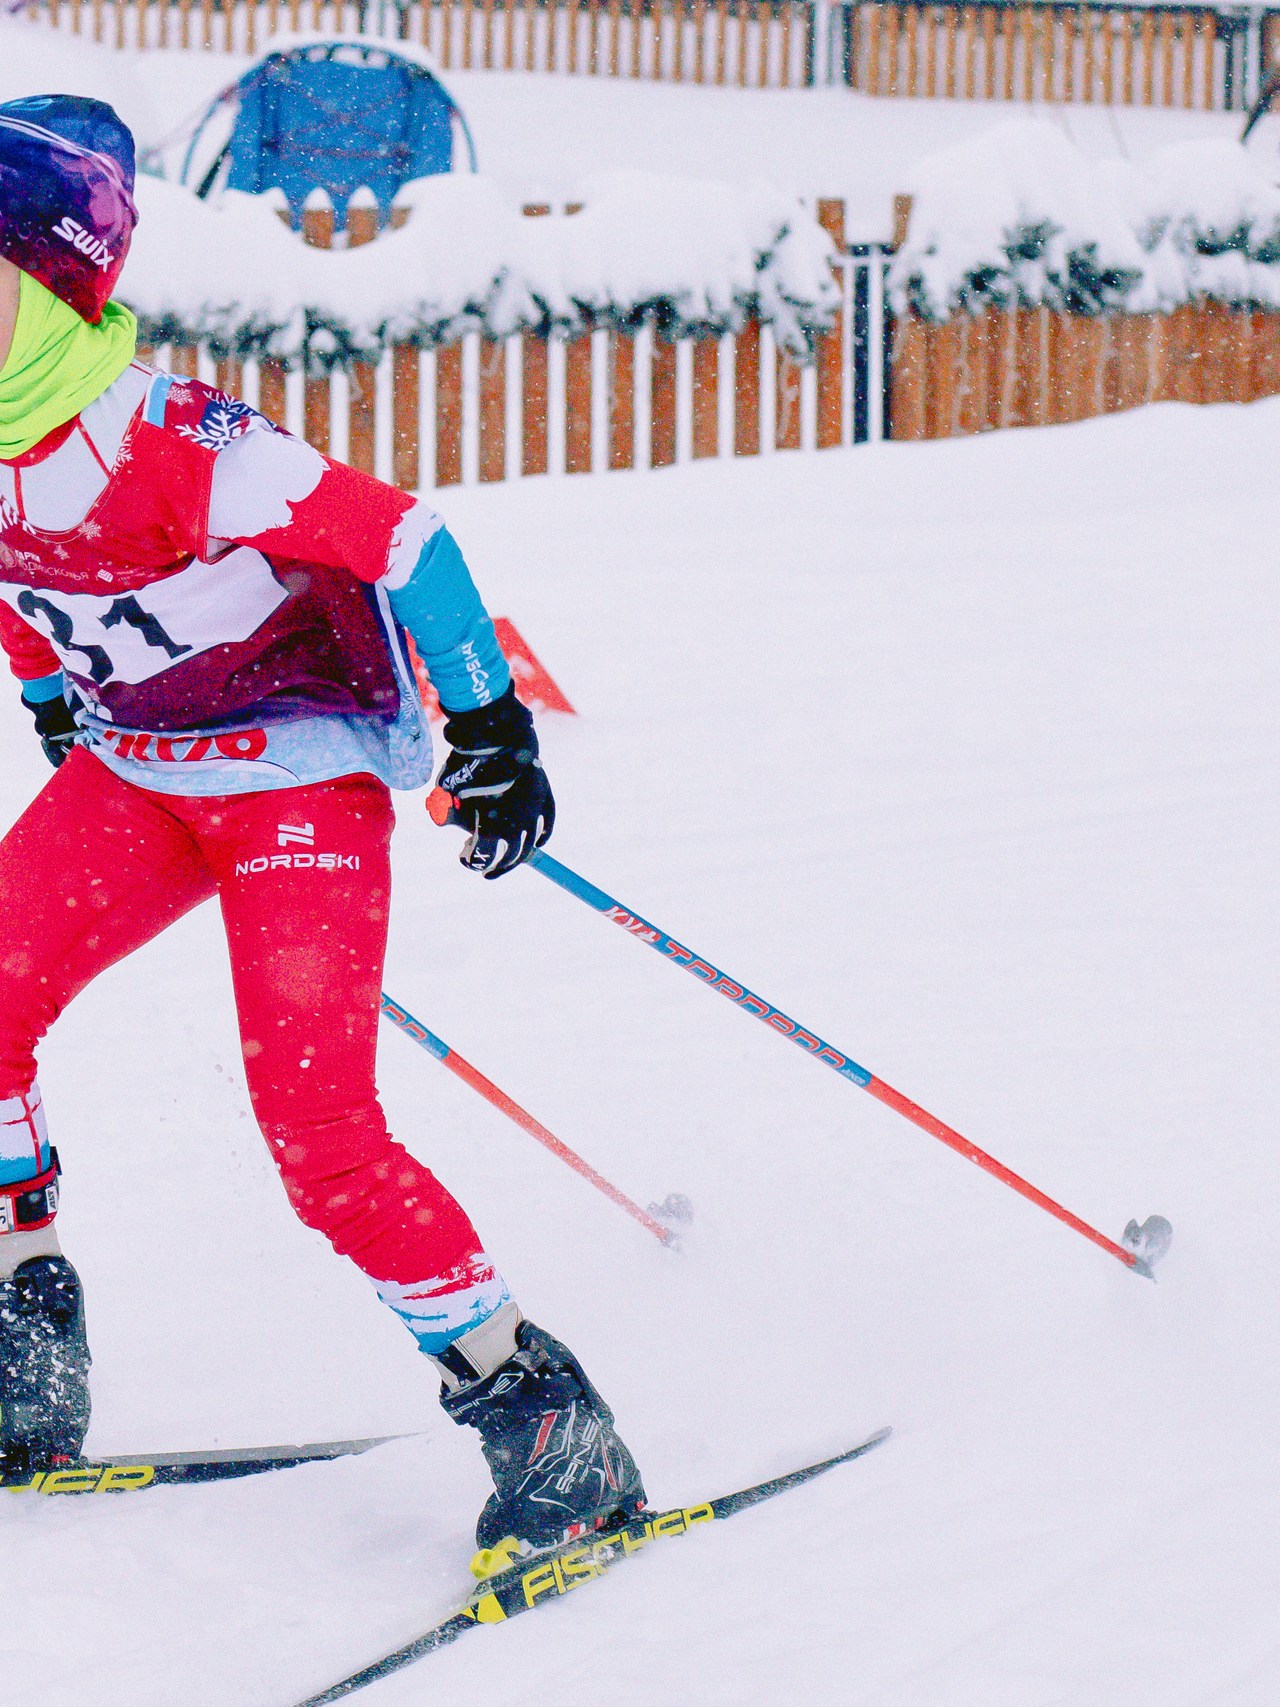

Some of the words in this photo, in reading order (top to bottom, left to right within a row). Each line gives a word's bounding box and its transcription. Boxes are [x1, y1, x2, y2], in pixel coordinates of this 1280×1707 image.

[17, 590, 194, 684] 31
[235, 853, 360, 877] NORDSKI
[522, 1502, 715, 1608] FISCHER
